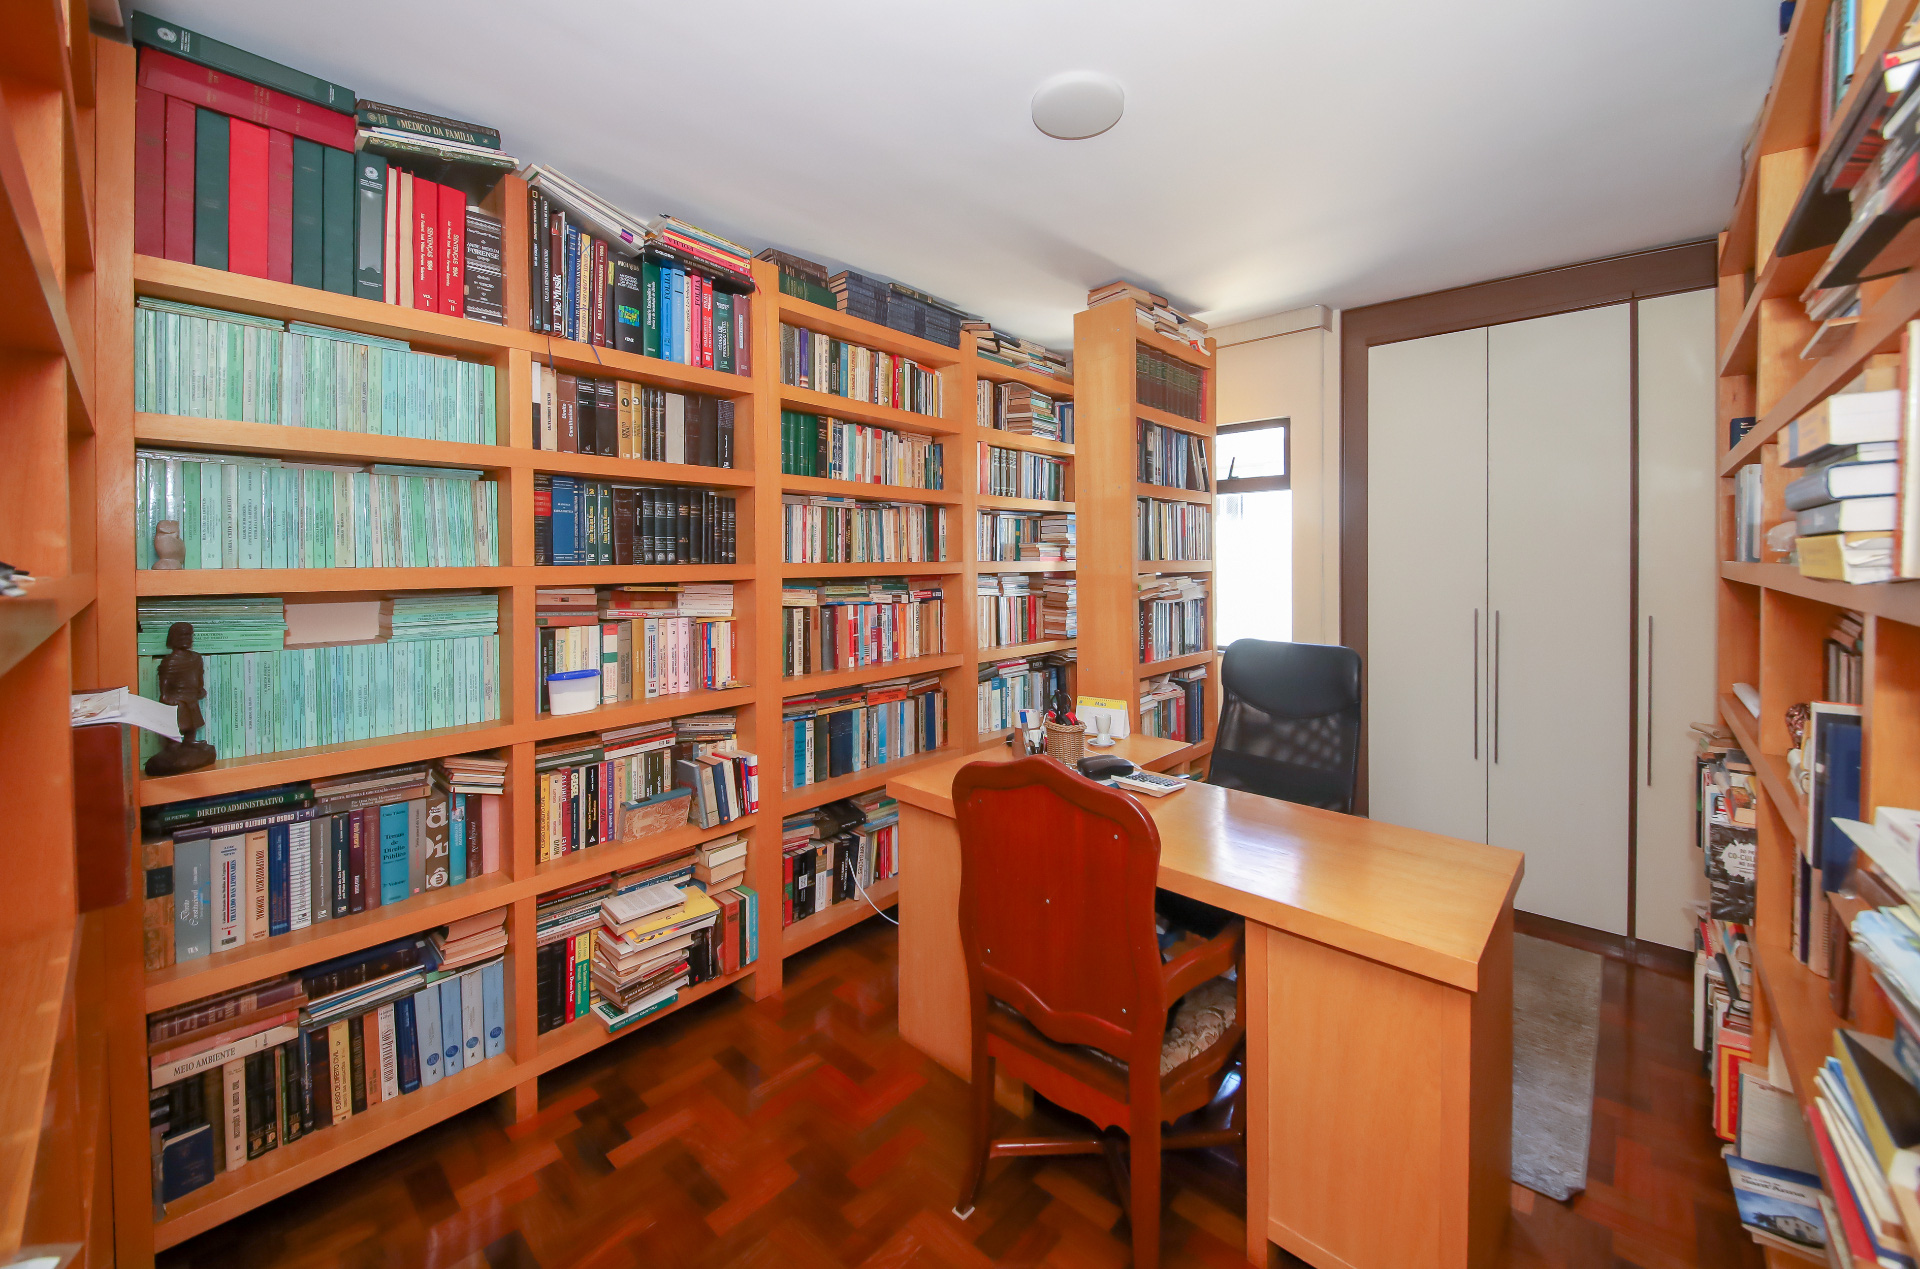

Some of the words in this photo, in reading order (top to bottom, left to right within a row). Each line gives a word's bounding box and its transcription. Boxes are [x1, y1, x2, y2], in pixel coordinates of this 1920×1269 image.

[433, 126, 444, 137] DA
[426, 226, 434, 258] SENTENÇAS
[553, 274, 562, 299] Musik
[553, 301, 562, 317] Die
[197, 805, 226, 818] DIREITO
[226, 796, 284, 813] ADMINISTRATIVO
[246, 817, 267, 828] DIREITO
[268, 816, 276, 824] DE
[277, 813, 295, 823] CURSO
[211, 822, 244, 834] COMERCIAL
[384, 846, 405, 854] Direito
[383, 851, 407, 861] Público
[173, 1061, 195, 1076] MEIO
[195, 1047, 236, 1068] AMBIENTE
